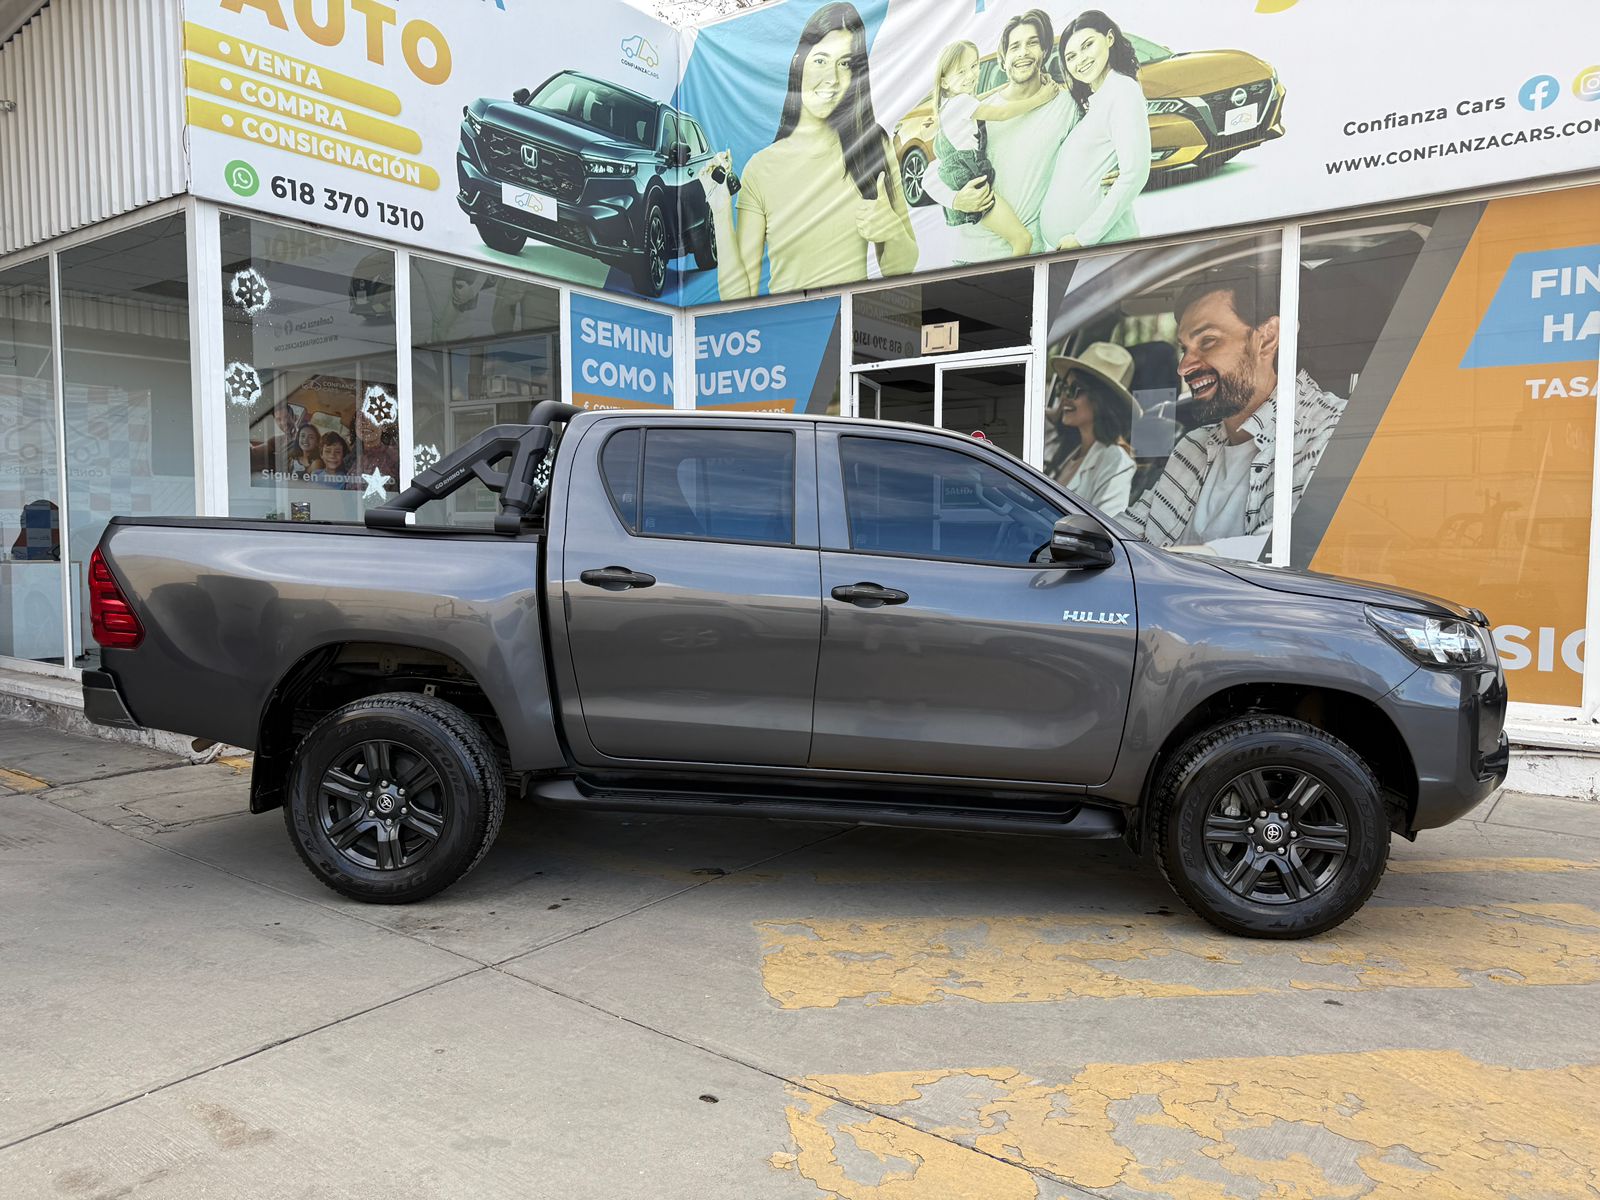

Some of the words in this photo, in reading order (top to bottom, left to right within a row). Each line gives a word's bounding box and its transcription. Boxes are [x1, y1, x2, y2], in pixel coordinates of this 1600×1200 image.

[239, 43, 323, 90] VENTA
[620, 58, 660, 80] CONFIANZACARS
[240, 80, 347, 130] COMPRA
[1343, 107, 1448, 137] Confianza
[1456, 96, 1506, 117] Cars
[242, 117, 420, 185] CONSIGNACIÓN
[271, 175, 315, 206] 618
[323, 187, 369, 218] 370
[376, 201, 424, 231] 1310
[581, 358, 657, 392] COMO
[261, 468, 299, 482] Sigue
[302, 473, 319, 482] en
[1062, 610, 1131, 626] HILUX
